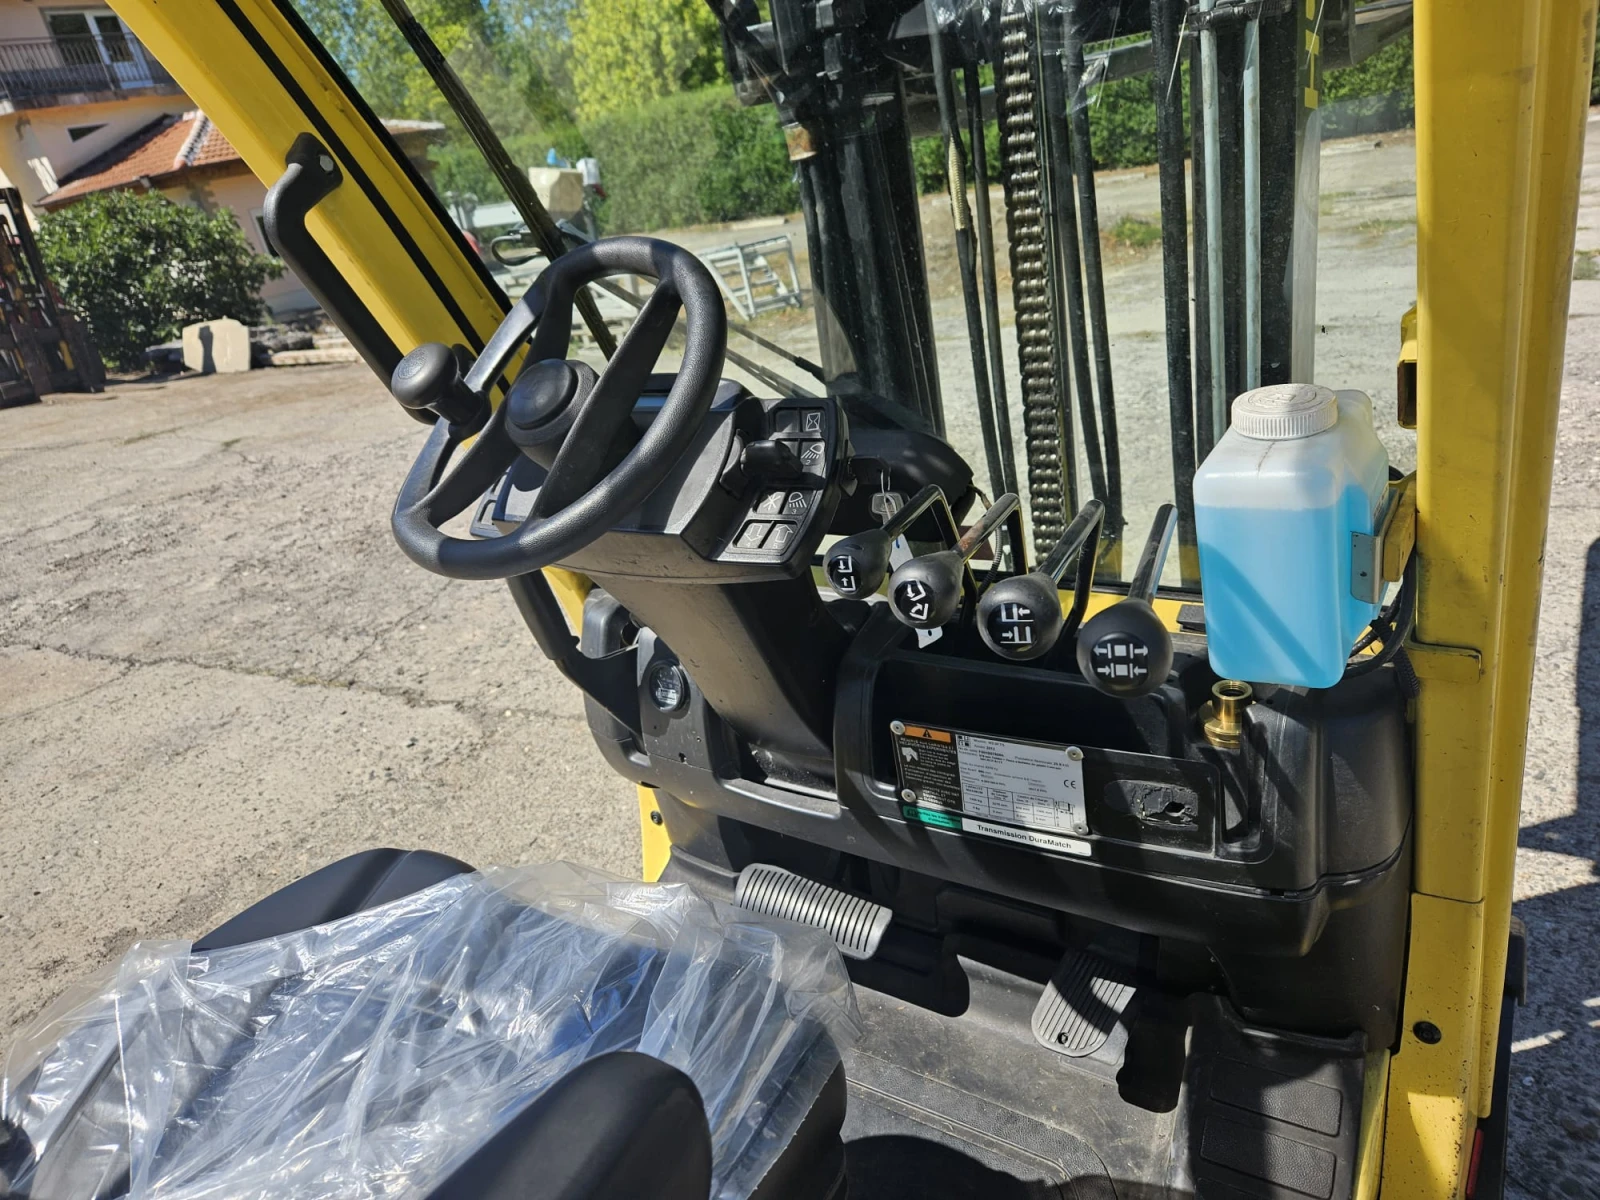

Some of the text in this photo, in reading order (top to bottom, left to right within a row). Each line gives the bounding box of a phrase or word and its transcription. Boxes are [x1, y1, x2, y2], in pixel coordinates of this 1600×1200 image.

[1063, 779, 1077, 790] CE
[977, 824, 1072, 849] Transmission DuraMatch
